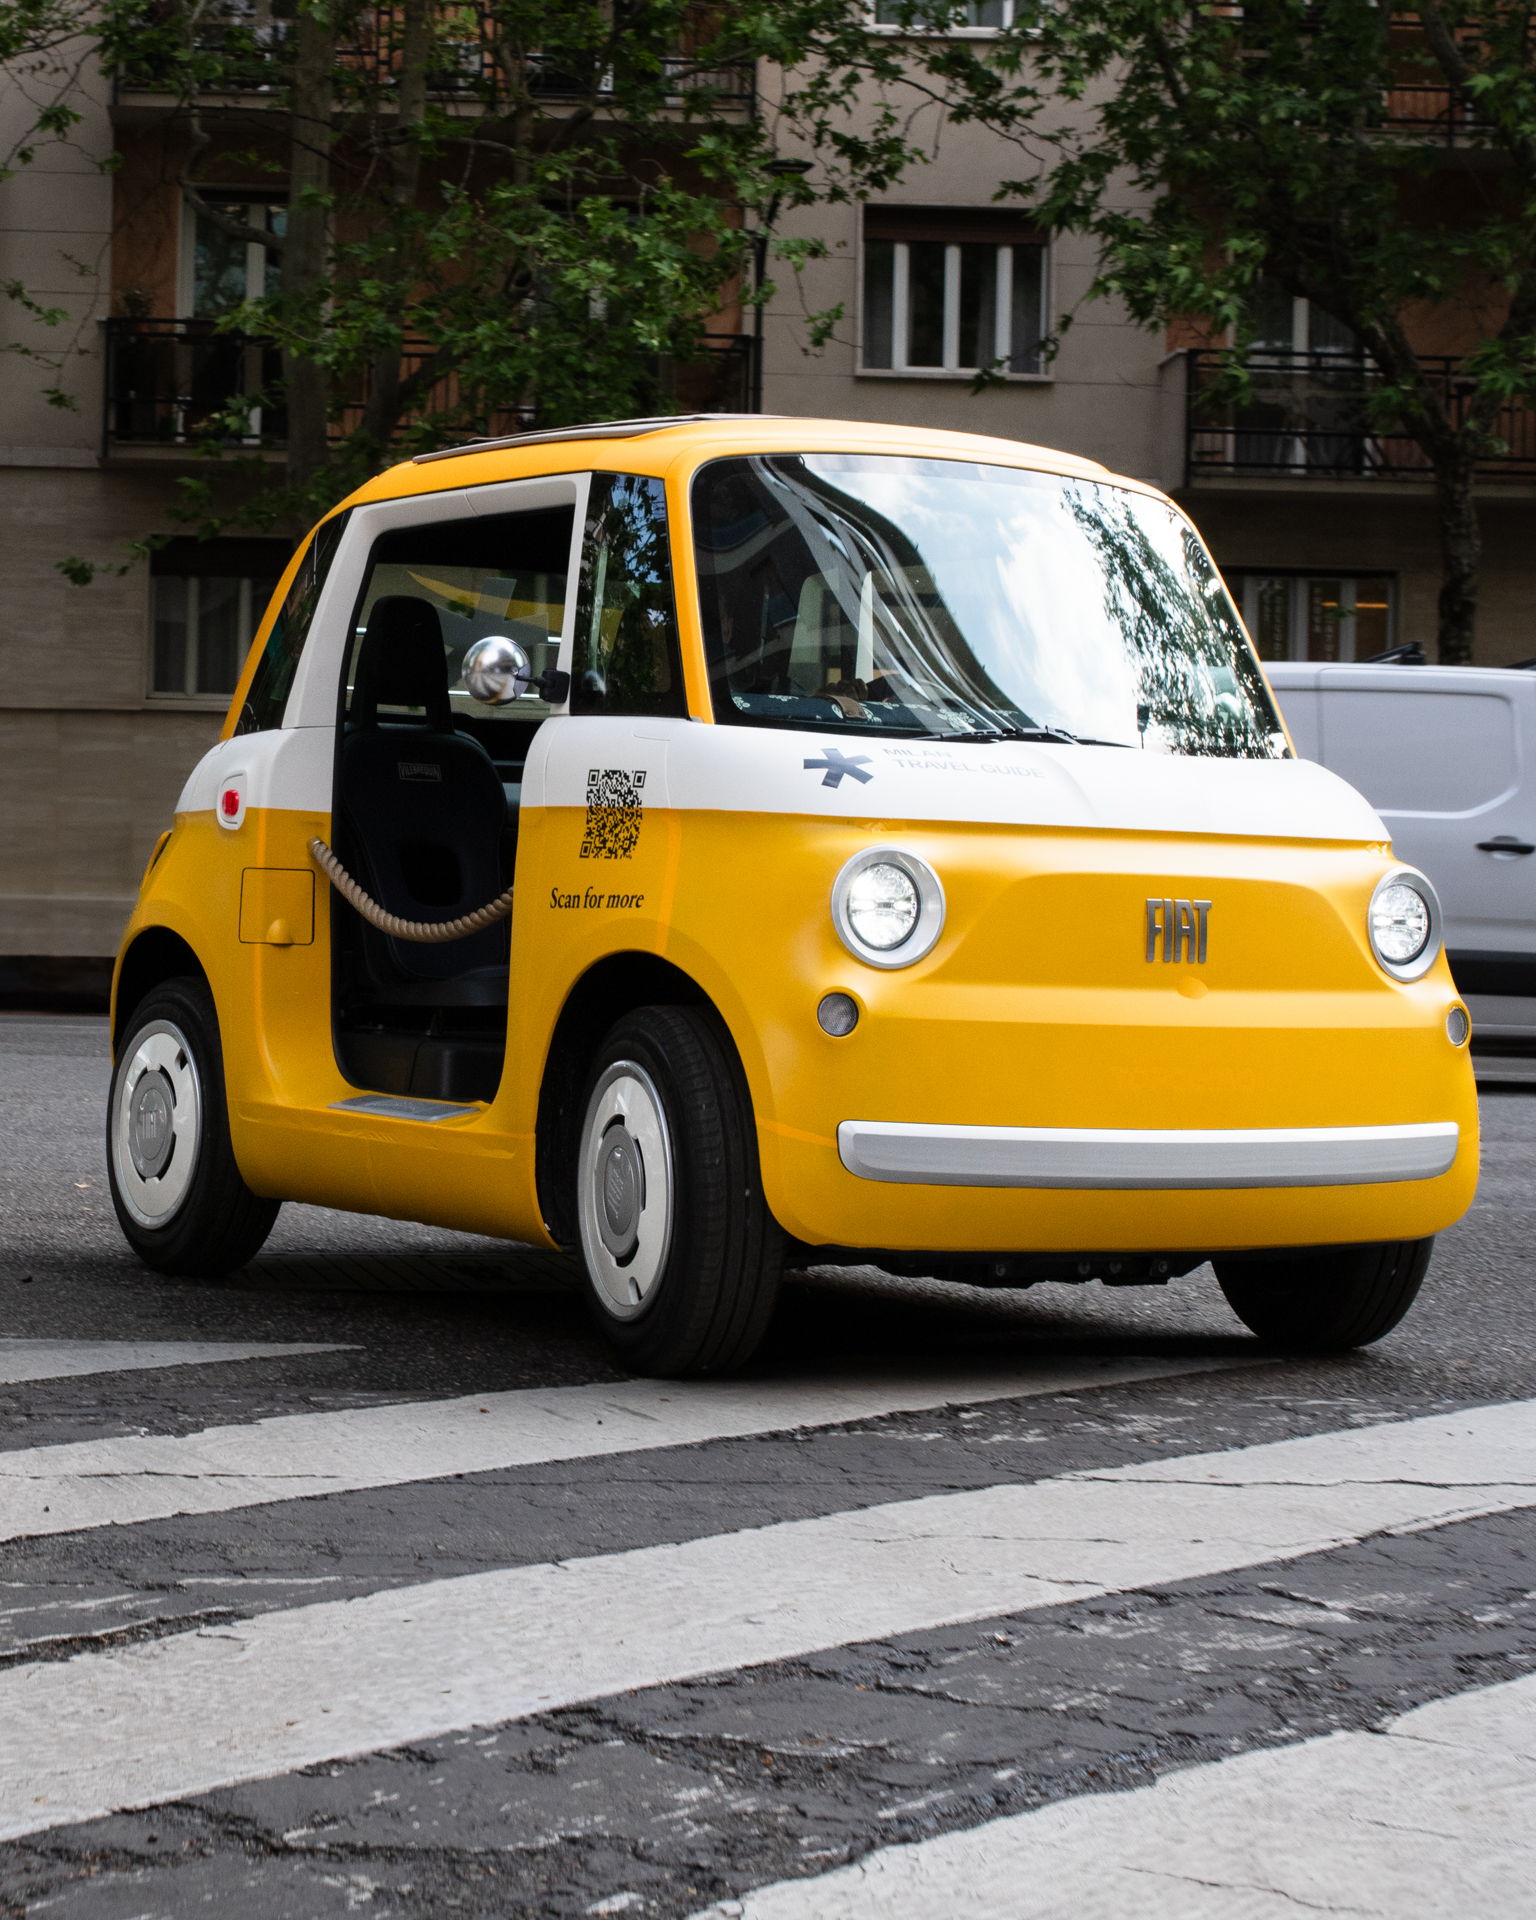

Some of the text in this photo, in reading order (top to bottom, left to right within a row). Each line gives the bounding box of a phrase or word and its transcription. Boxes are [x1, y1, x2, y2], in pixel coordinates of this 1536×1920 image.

[882, 748, 953, 759] MILAN
[891, 759, 1046, 779] TRAVEL GUIDE
[550, 886, 645, 909] Scan for more
[1146, 898, 1212, 964] FIAT
